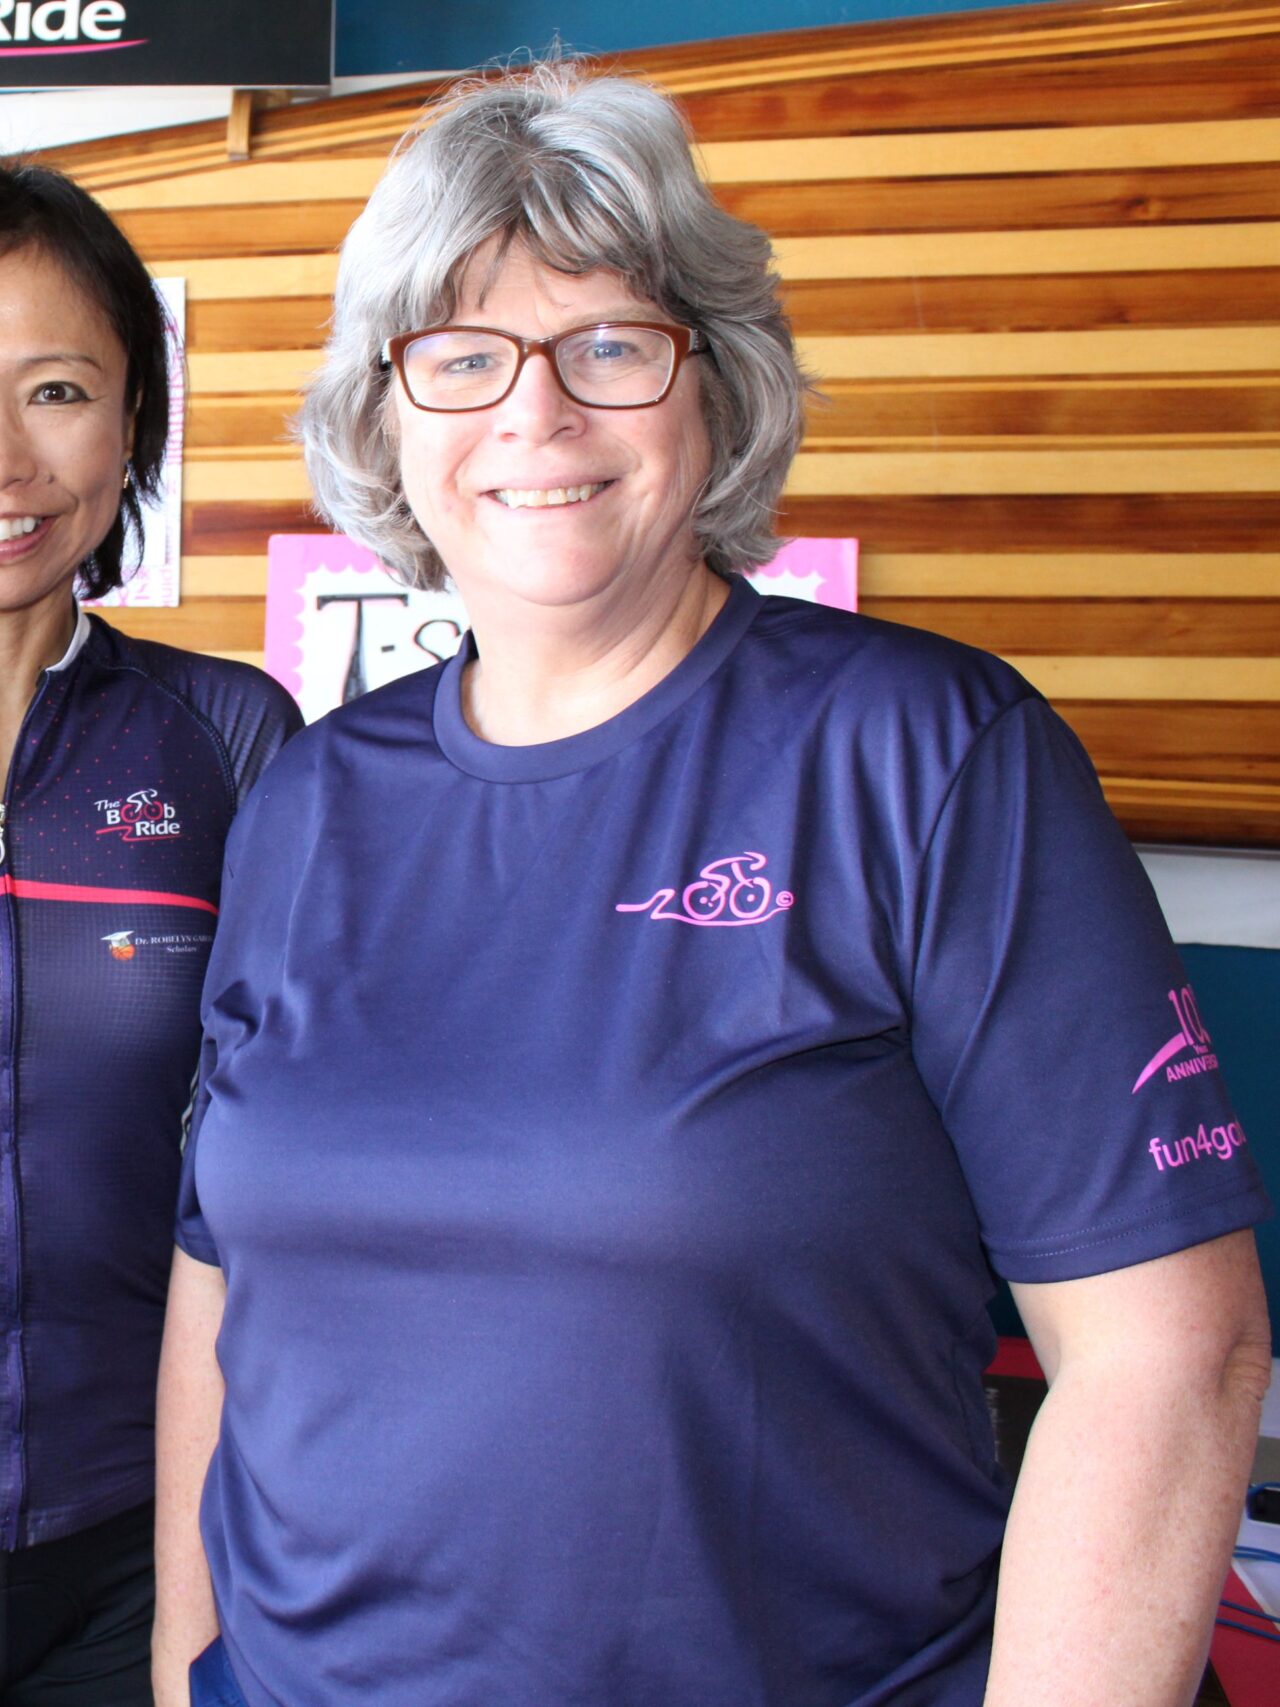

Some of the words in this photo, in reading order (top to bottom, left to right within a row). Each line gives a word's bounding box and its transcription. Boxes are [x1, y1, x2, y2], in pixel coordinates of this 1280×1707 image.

[94, 799, 121, 811] The
[135, 821, 180, 836] Ride
[135, 937, 149, 945] Dr.
